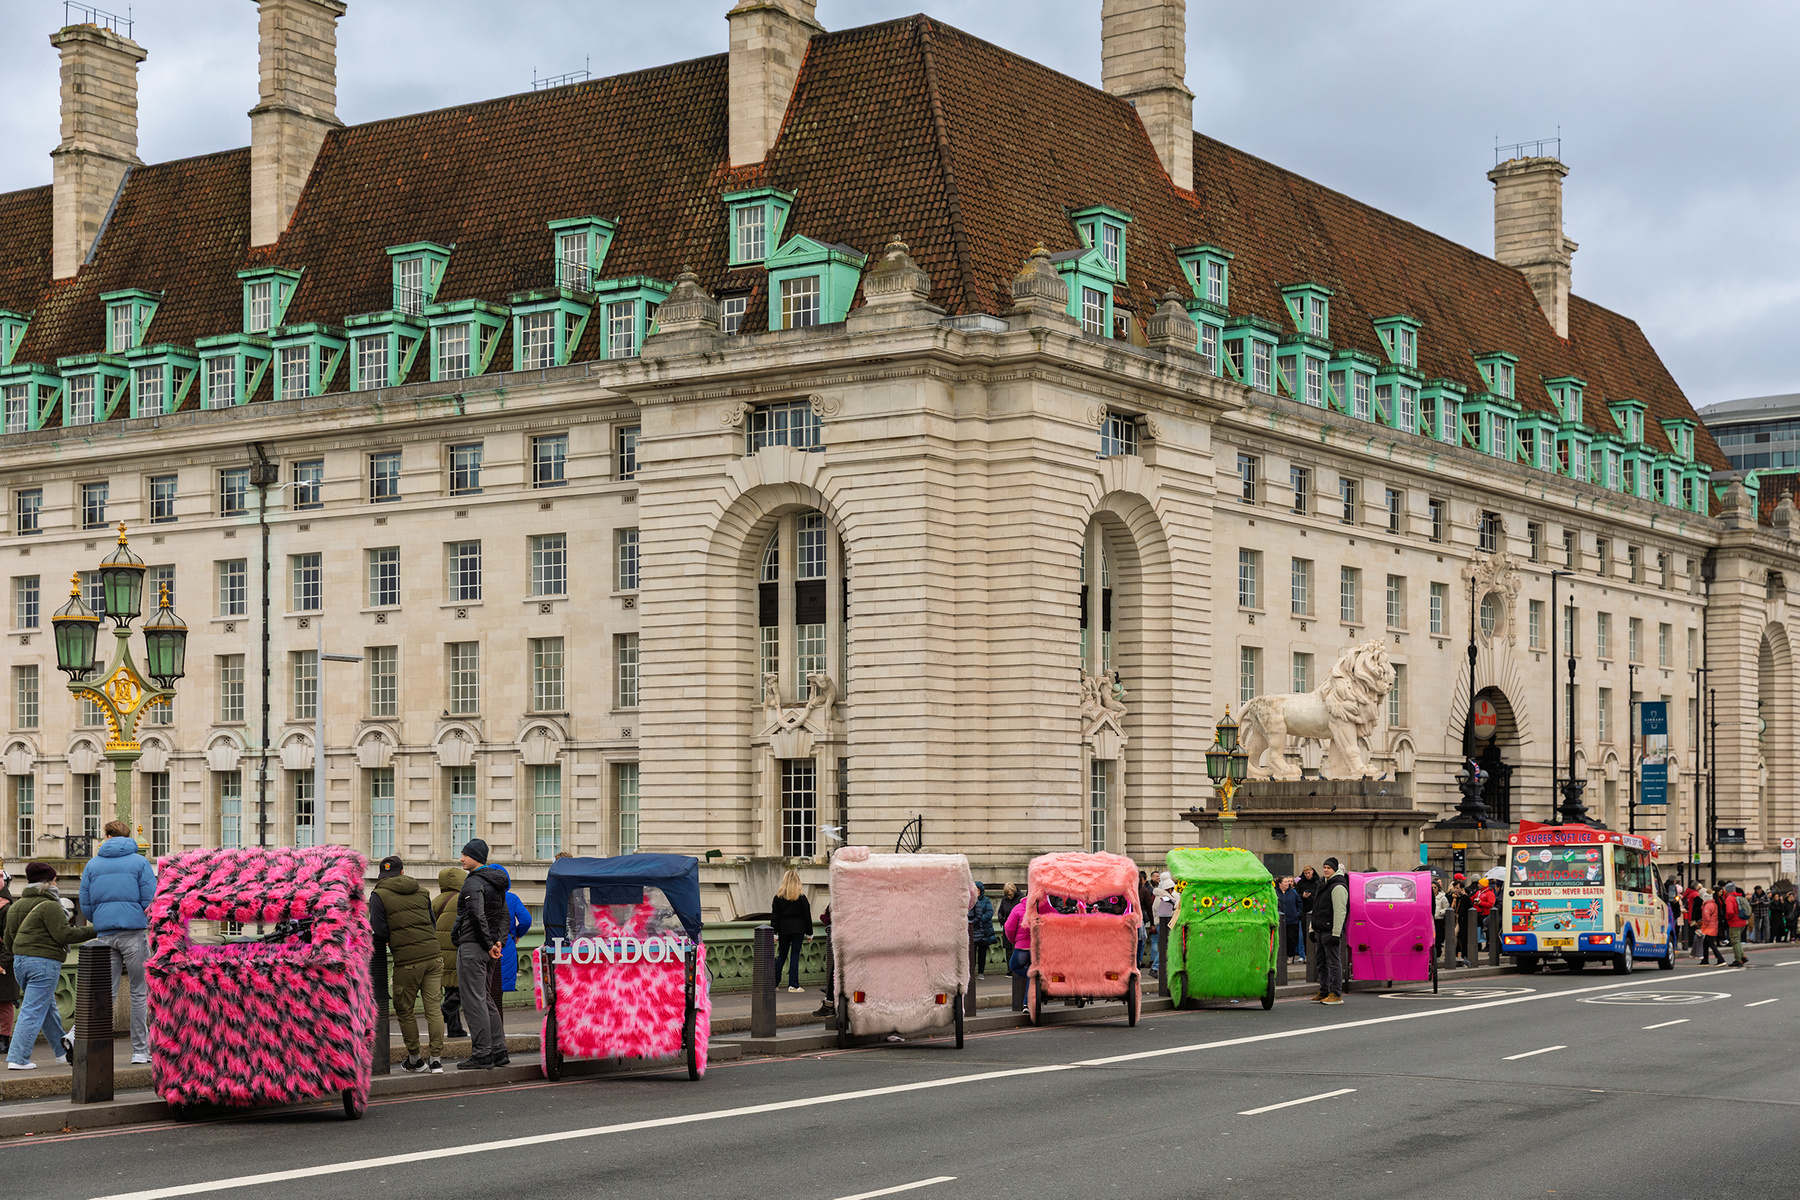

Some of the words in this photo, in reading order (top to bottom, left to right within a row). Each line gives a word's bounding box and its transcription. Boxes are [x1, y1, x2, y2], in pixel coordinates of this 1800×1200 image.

[1525, 834, 1553, 844] SUPER
[1554, 833, 1576, 843] SOFT
[1578, 833, 1591, 842] ICE
[1528, 870, 1551, 880] HOT
[1553, 869, 1585, 880] DOGS
[1533, 888, 1552, 896] LICKED
[552, 936, 687, 964] LONDON
